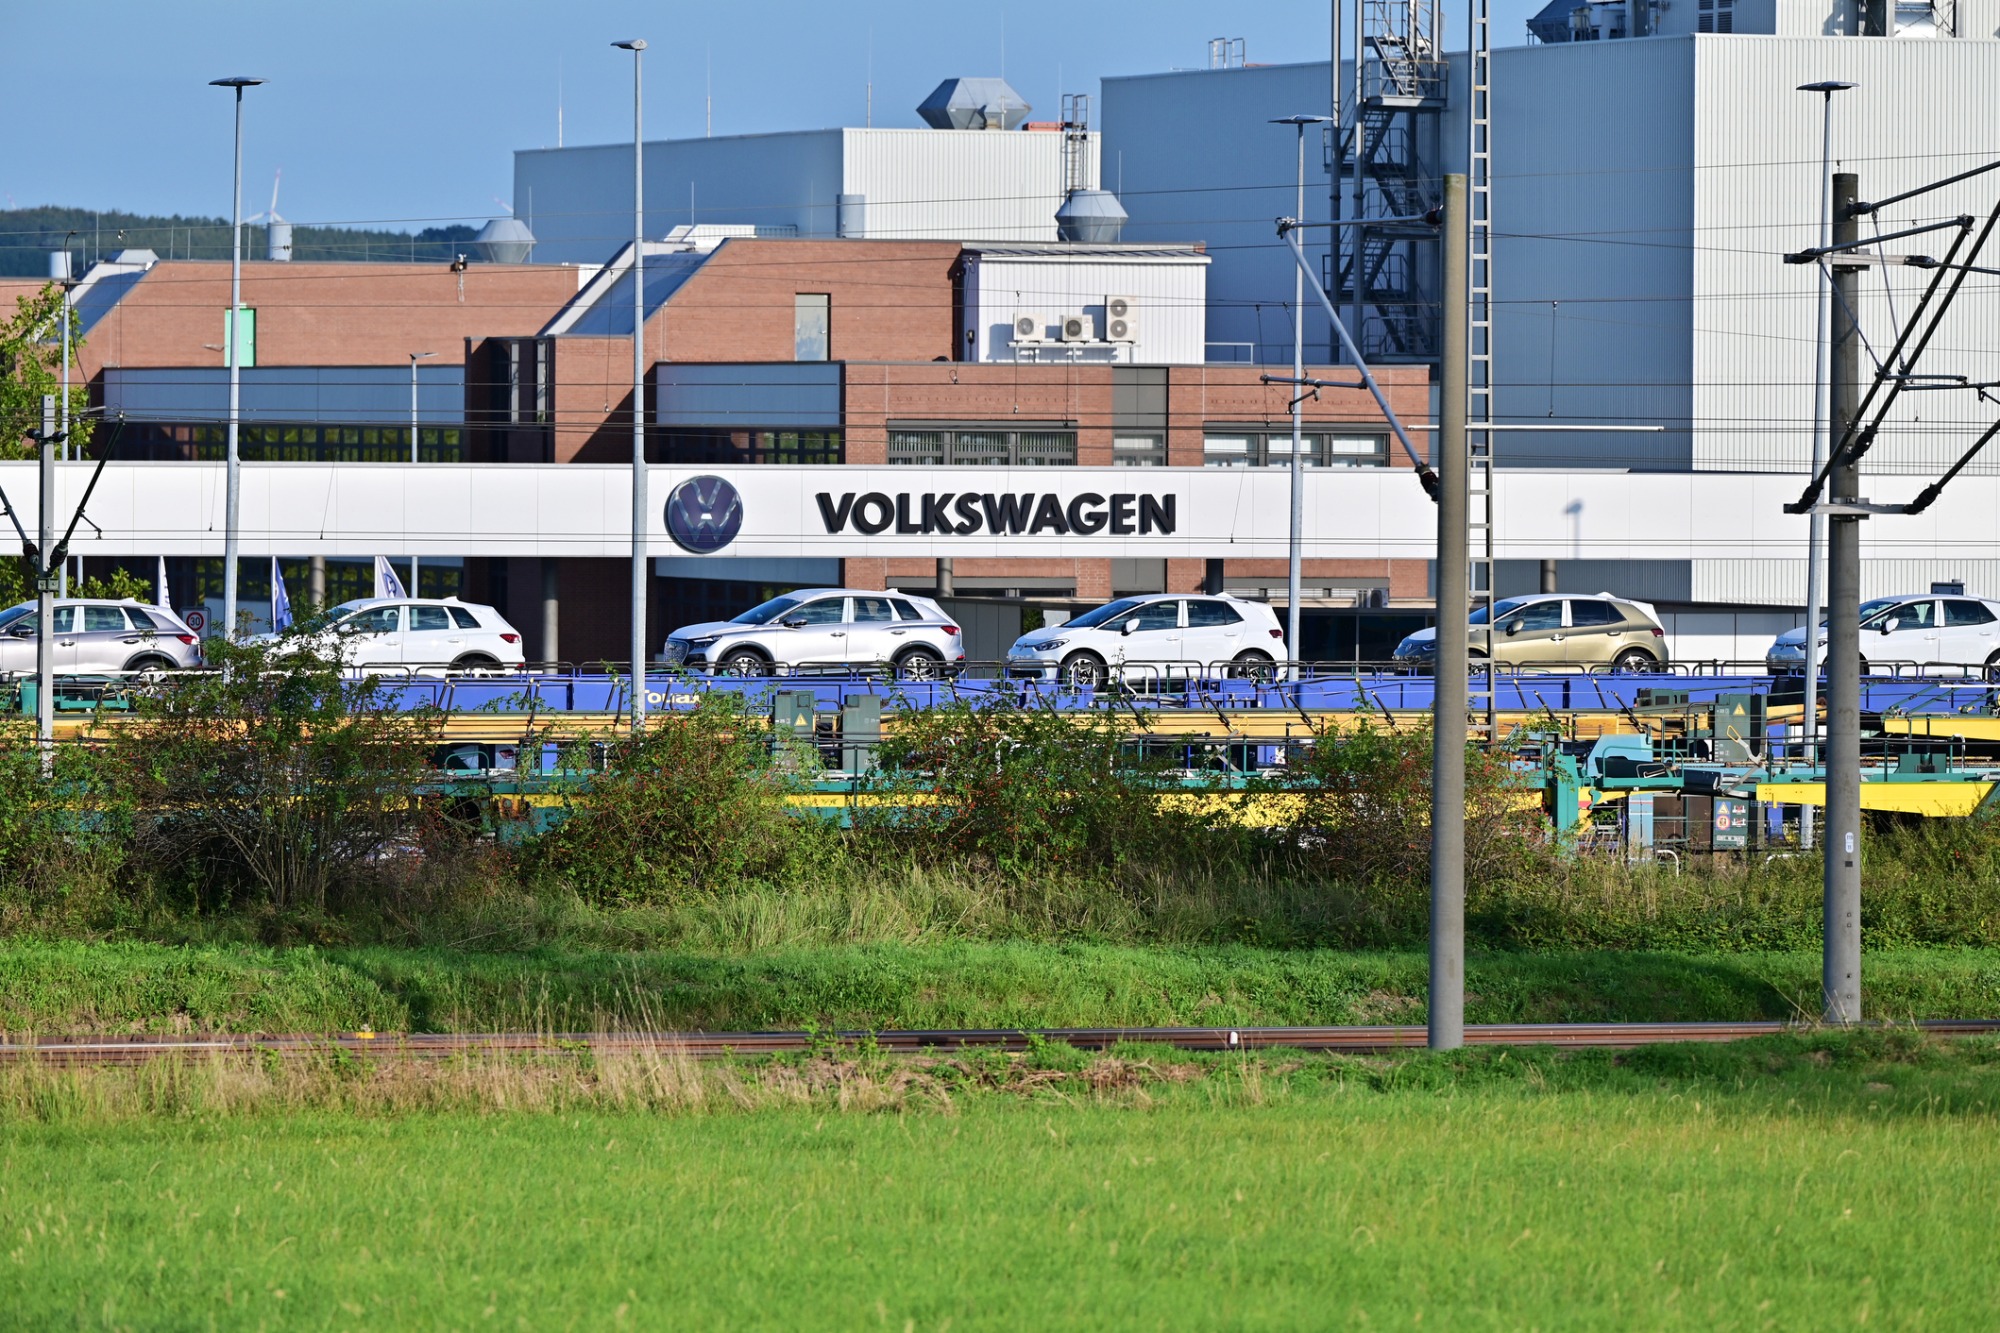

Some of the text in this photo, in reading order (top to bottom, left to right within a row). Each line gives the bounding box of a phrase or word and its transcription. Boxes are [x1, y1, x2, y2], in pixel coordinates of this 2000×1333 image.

[667, 476, 743, 549] VW
[816, 492, 1176, 535] VOLKSWAGEN
[190, 616, 201, 627] 30
